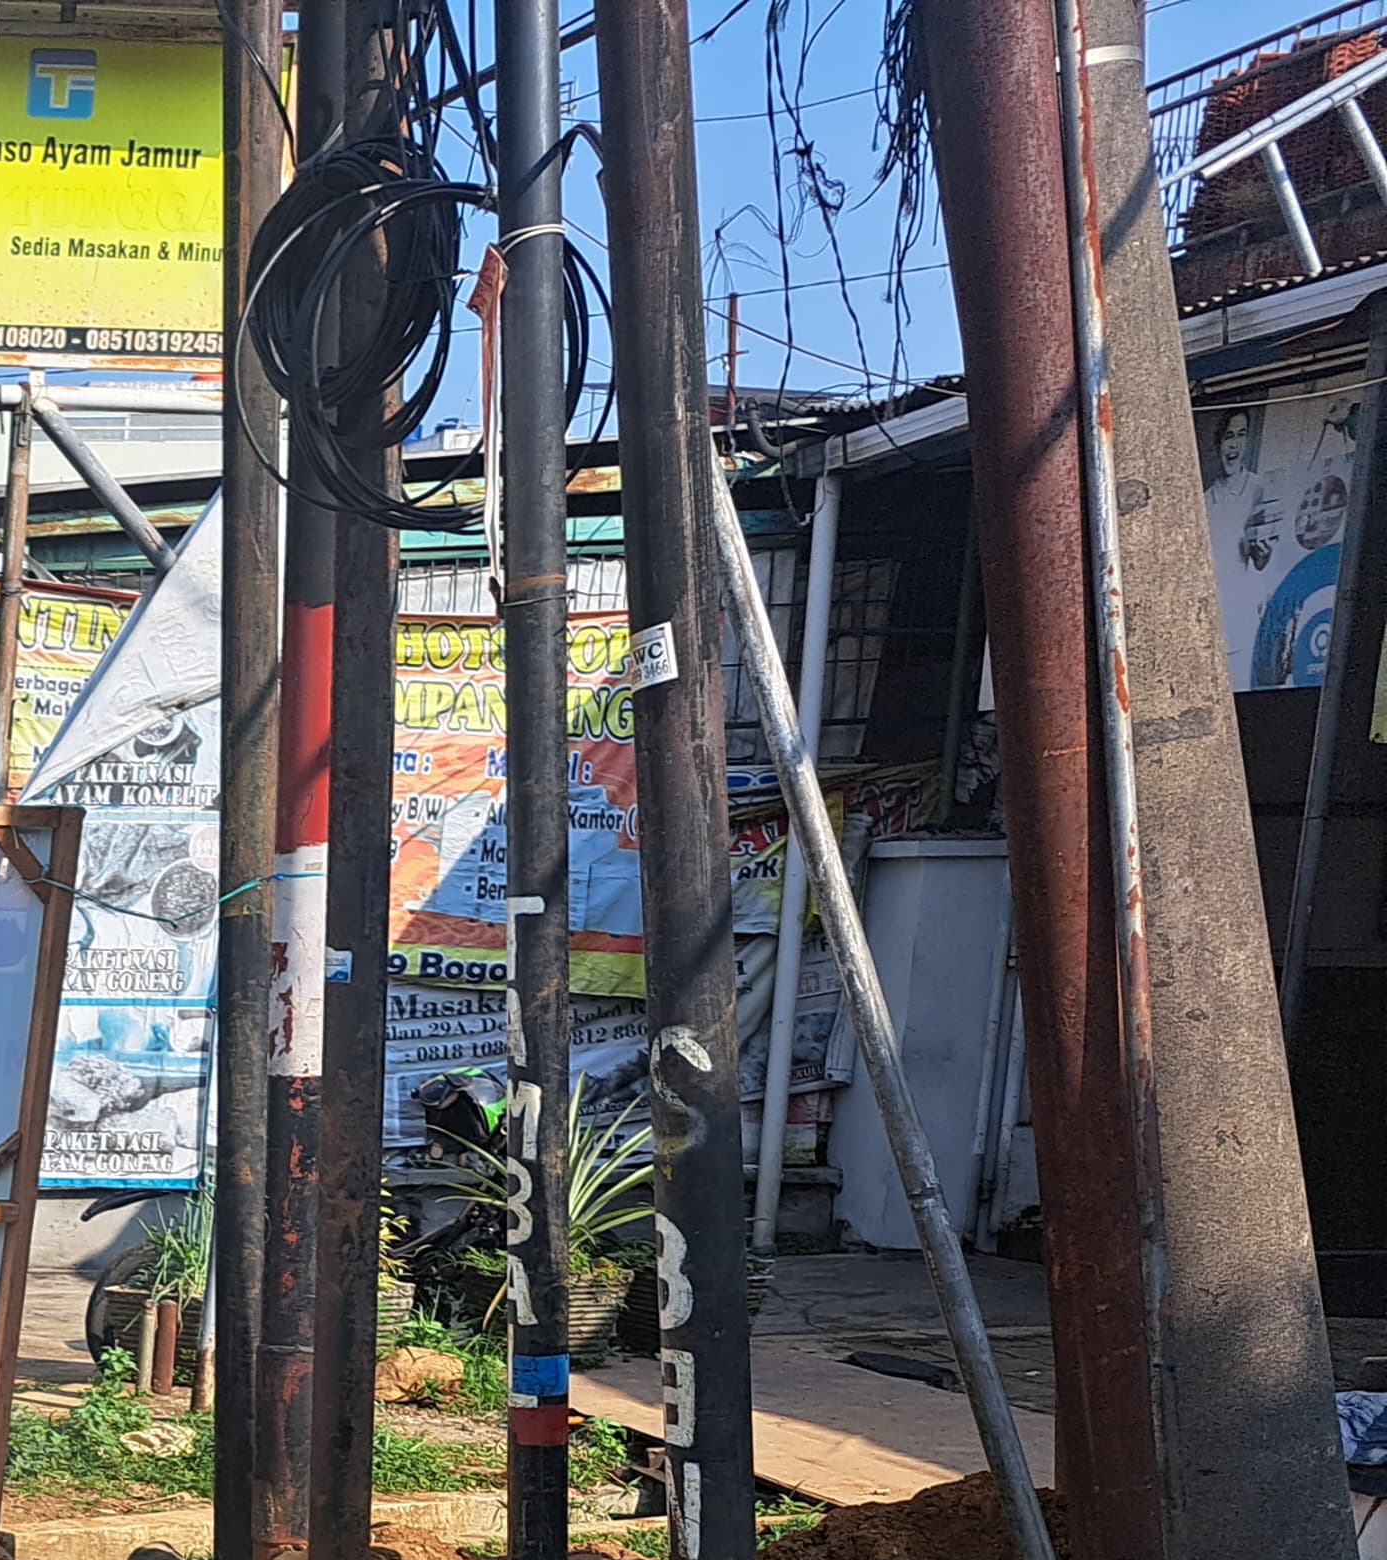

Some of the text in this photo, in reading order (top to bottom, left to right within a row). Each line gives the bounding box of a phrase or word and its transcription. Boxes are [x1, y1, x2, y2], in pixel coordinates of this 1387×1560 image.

[41, 136, 112, 170] Ayam
[120, 140, 202, 169] Jamur
[10, 236, 61, 258] Sedia
[68, 238, 150, 260] Masakan
[157, 241, 170, 260] &
[632, 641, 664, 666] WC
[13, 674, 90, 697] erbagai
[144, 761, 194, 785] NASI
[126, 948, 177, 972] NASI
[106, 970, 184, 992] GORENG
[44, 1130, 162, 1153] PAKET NASI
[96, 1152, 173, 1173] GORENG
